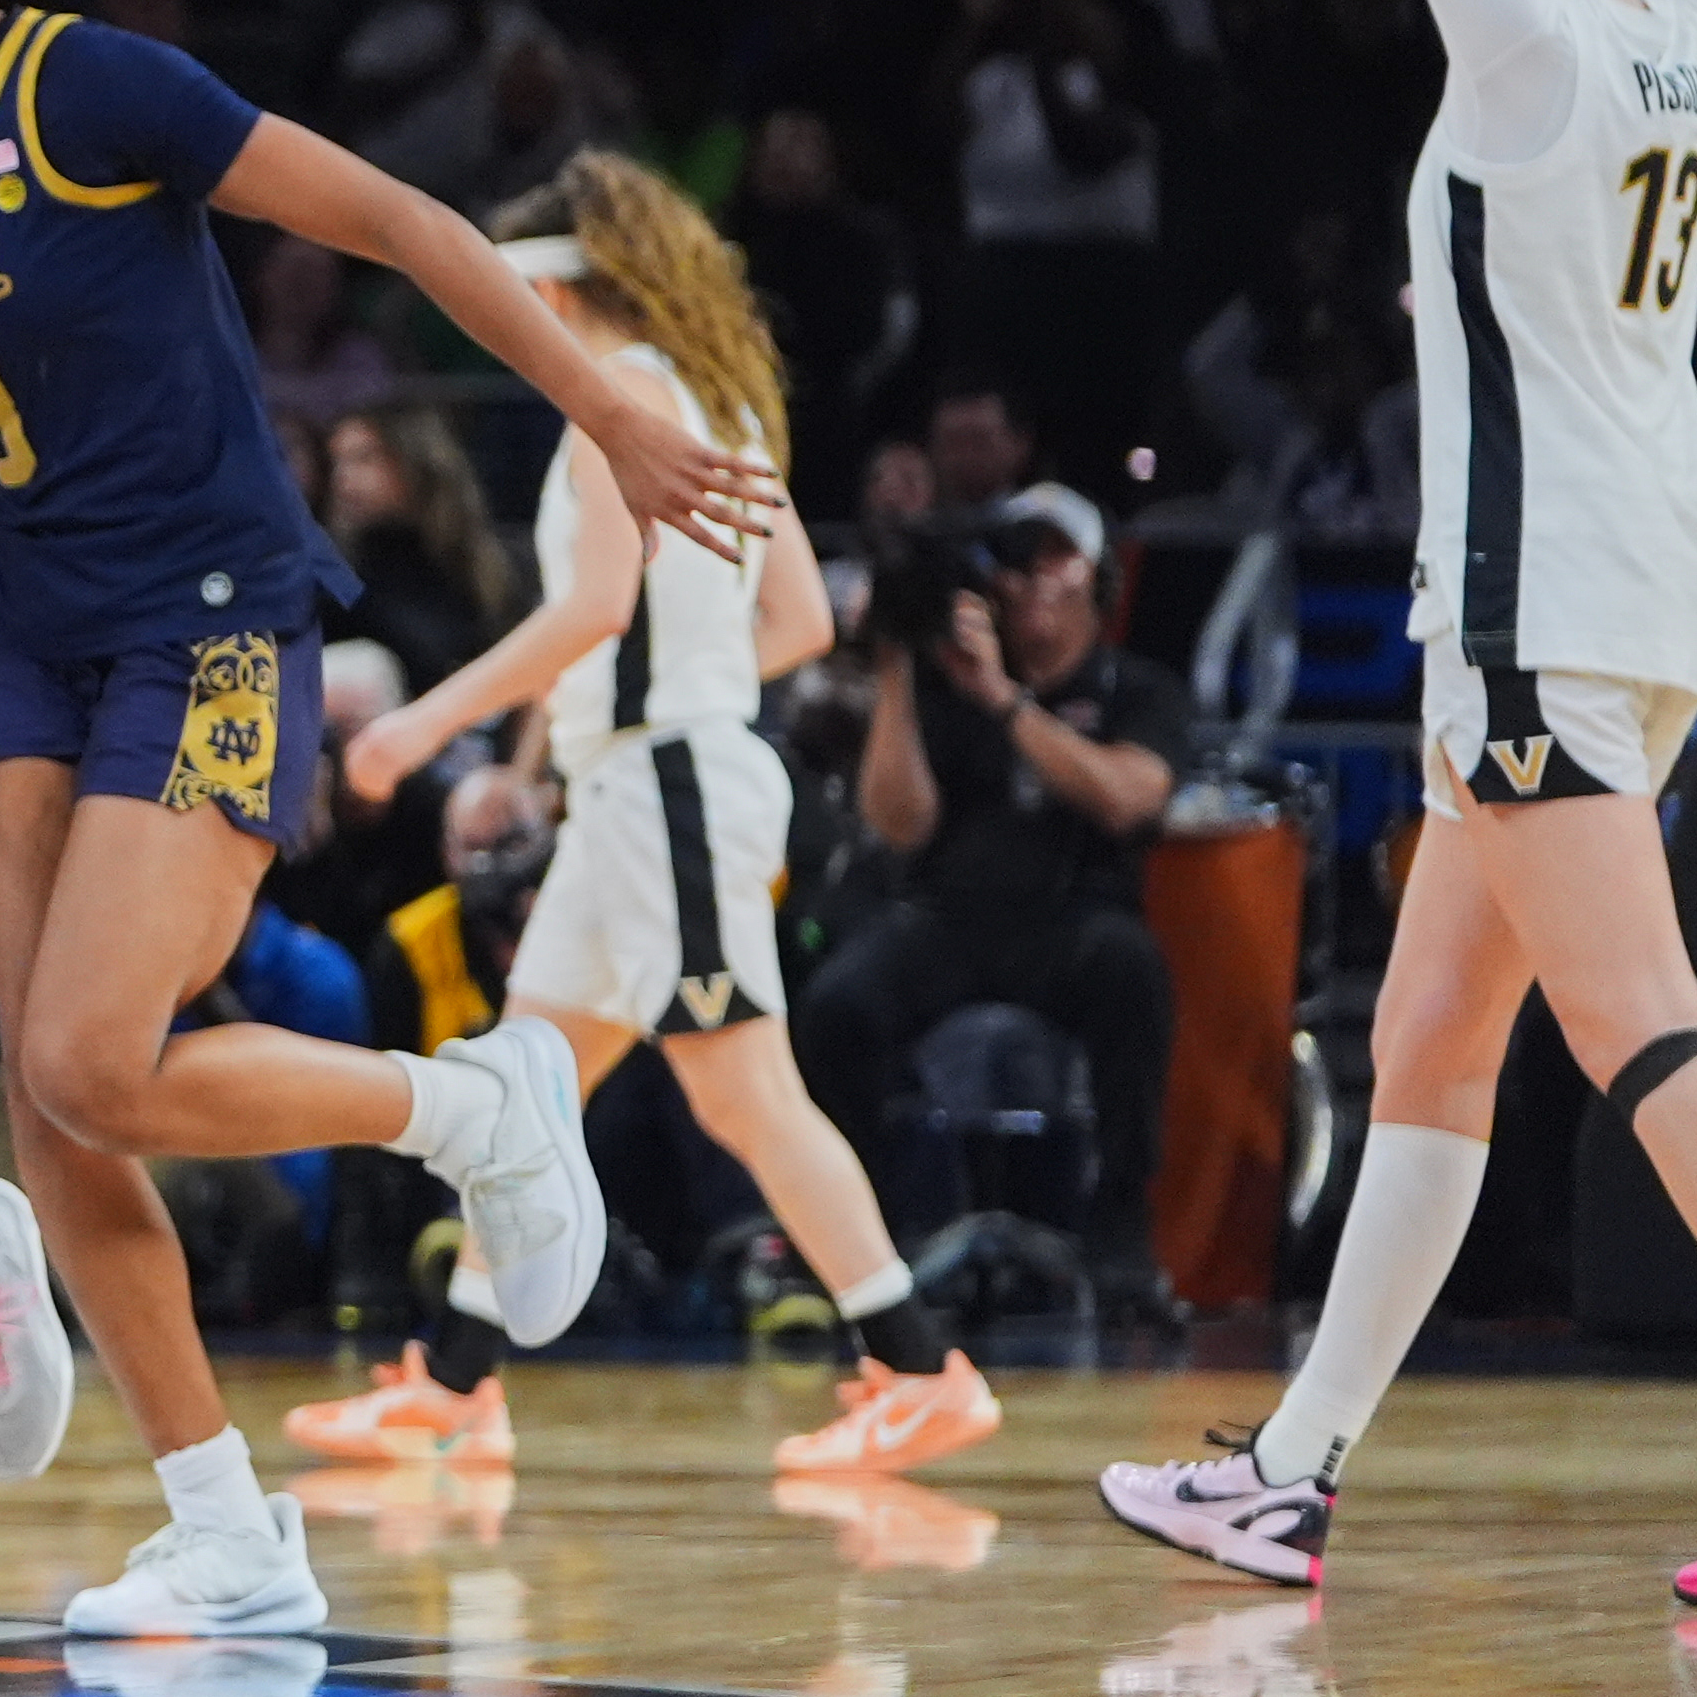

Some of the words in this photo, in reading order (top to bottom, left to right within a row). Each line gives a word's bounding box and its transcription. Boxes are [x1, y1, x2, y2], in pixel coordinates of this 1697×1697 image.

[1616, 144, 1697, 314] 13
[1486, 734, 1554, 797] V
[678, 971, 734, 1029] V
